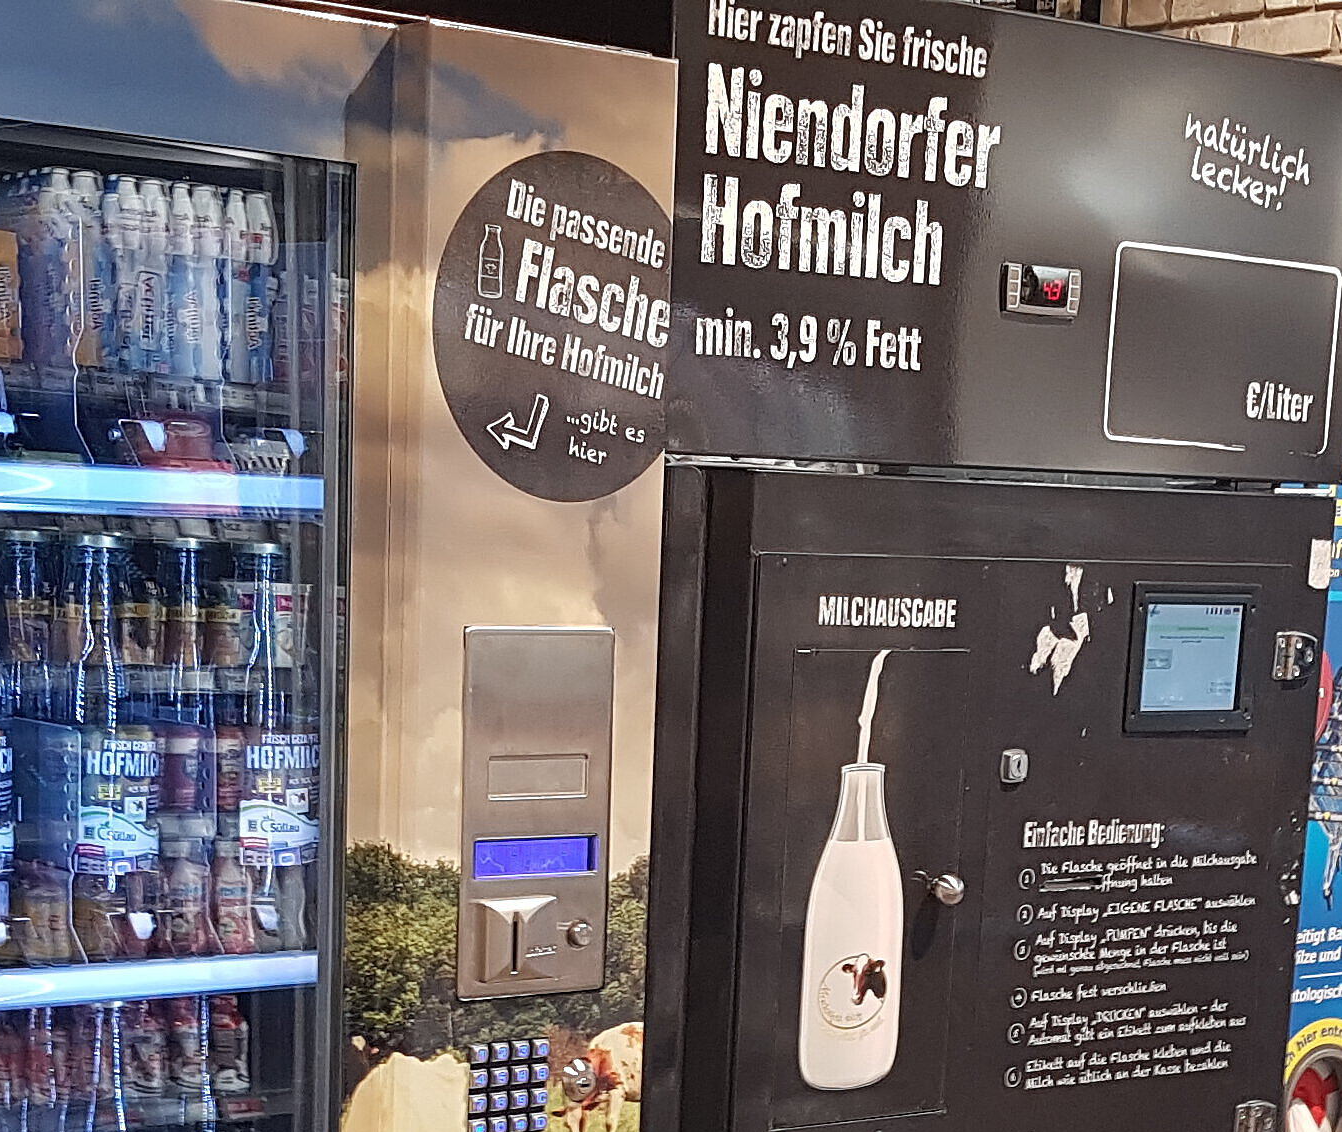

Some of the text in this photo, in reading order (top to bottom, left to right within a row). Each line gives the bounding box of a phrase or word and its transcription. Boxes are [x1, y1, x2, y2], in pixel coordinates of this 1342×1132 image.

[707, 0, 987, 78] Hier zapfen Sie frische
[705, 62, 1001, 189] Niendorfer
[1184, 112, 1310, 186] natürlich
[1190, 155, 1287, 211] lecker!
[506, 178, 665, 268] Die passende
[700, 173, 943, 286] Hofmilch
[515, 238, 671, 349] Flasche
[464, 304, 664, 399] für Ihre Hofmilch
[695, 306, 922, 371] min. 3,9 % Fett
[1246, 381, 1314, 423] €/Liter
[625, 427, 645, 443] es
[569, 437, 607, 465] hier
[818, 596, 957, 629] MILCHAUSGABE
[1023, 819, 1165, 848] Einfache Bedienung:
[1061, 850, 1257, 875] Flasche geöffnet in die Milchausgabe
[1141, 874, 1173, 887] halten
[1037, 907, 1100, 923] Auf Display
[1035, 920, 1238, 949] Auf Display bis die
[1150, 938, 1227, 955] der Flasche ist
[1319, 949, 1341, 962] und
[1031, 983, 1098, 1002] Flasche fest
[1028, 1000, 1228, 1030] Auf Display der
[1089, 1040, 1231, 1066] die Flasche die
[1296, 1031, 1318, 1051] hier
[1024, 1064, 1151, 1090] Milch der
